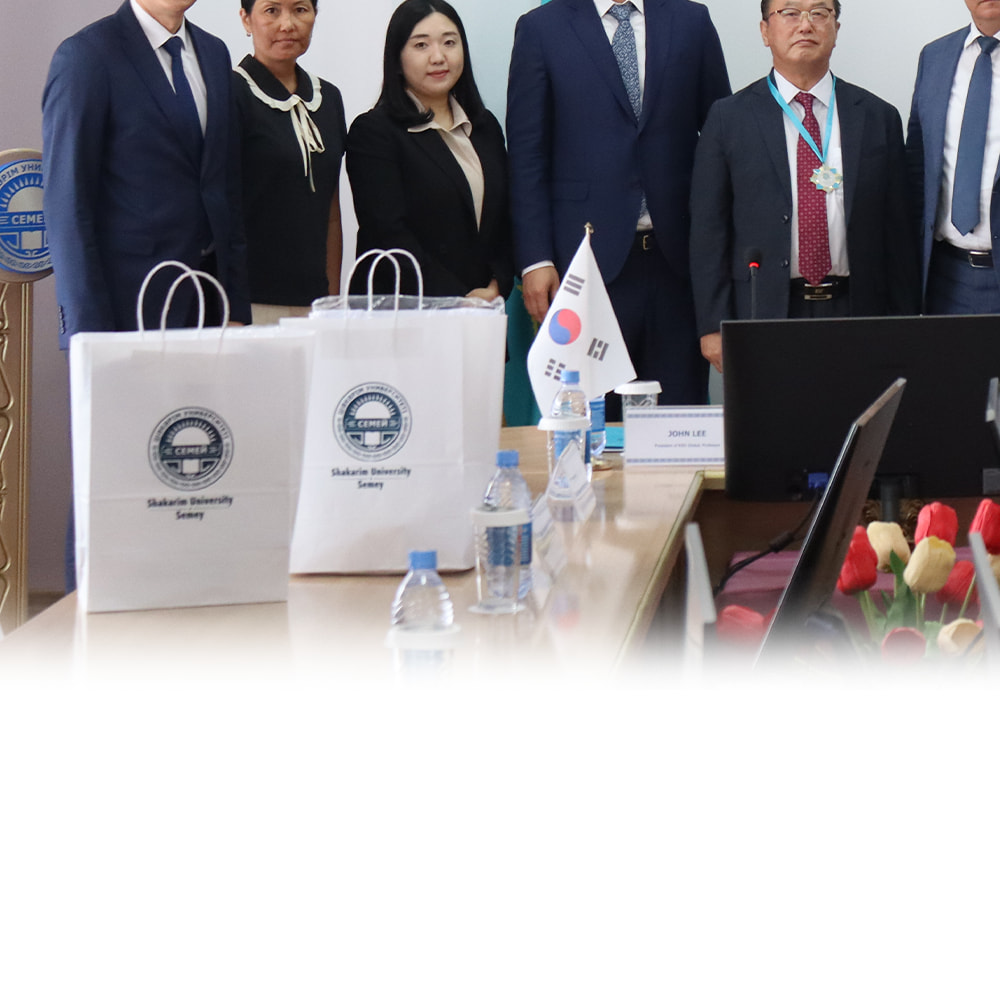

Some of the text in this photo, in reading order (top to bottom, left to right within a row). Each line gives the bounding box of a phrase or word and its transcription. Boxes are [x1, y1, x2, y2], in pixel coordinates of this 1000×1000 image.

[11, 214, 43, 224] СЕМЕ
[331, 465, 412, 478] Shakarim University
[358, 480, 385, 491] Semey
[147, 495, 234, 508] Shakarim University
[176, 511, 205, 521] Semey
